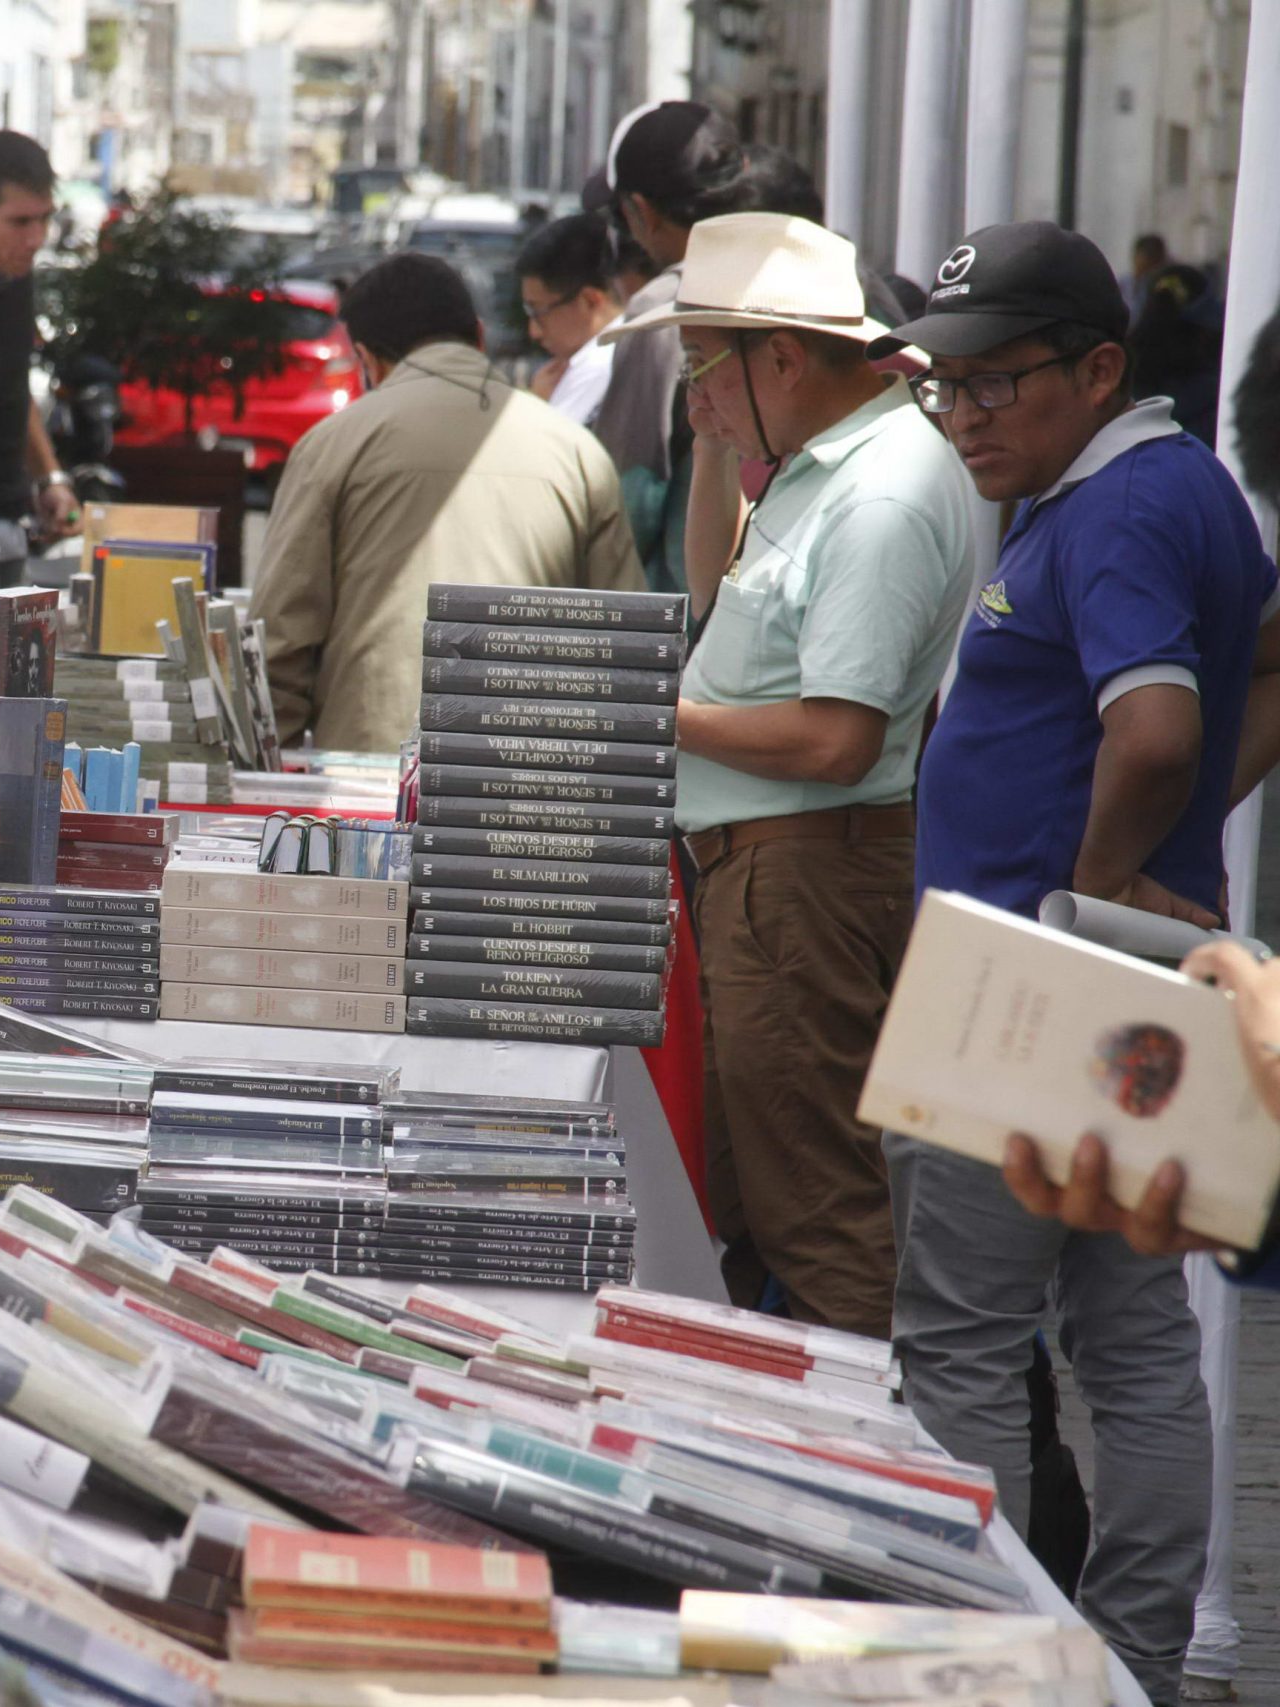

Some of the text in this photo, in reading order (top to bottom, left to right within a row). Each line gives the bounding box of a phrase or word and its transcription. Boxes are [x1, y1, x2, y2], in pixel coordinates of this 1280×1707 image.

[489, 605, 622, 621] EL SEÑOR ANILLOS III
[488, 738, 607, 754] DE LA TIERRA MEDIA
[500, 751, 563, 764] COMPLETA
[486, 833, 597, 848] CUENTOS DESDE EL
[490, 843, 592, 858] REINO PELIGROSO
[493, 869, 589, 884] EL SILMARILLION
[483, 896, 597, 912] LOS HIJOS DE HÚRIN
[512, 923, 573, 935] EL HOBBIT
[483, 938, 594, 954] CUENTOS DESDE EL
[487, 950, 589, 965] REINO PELIGROSO
[504, 971, 563, 984] TOLKIEN Y
[481, 983, 583, 998] LA GRAN GUERRA
[470, 1008, 602, 1026] EL SEÑOR ANILLOS III
